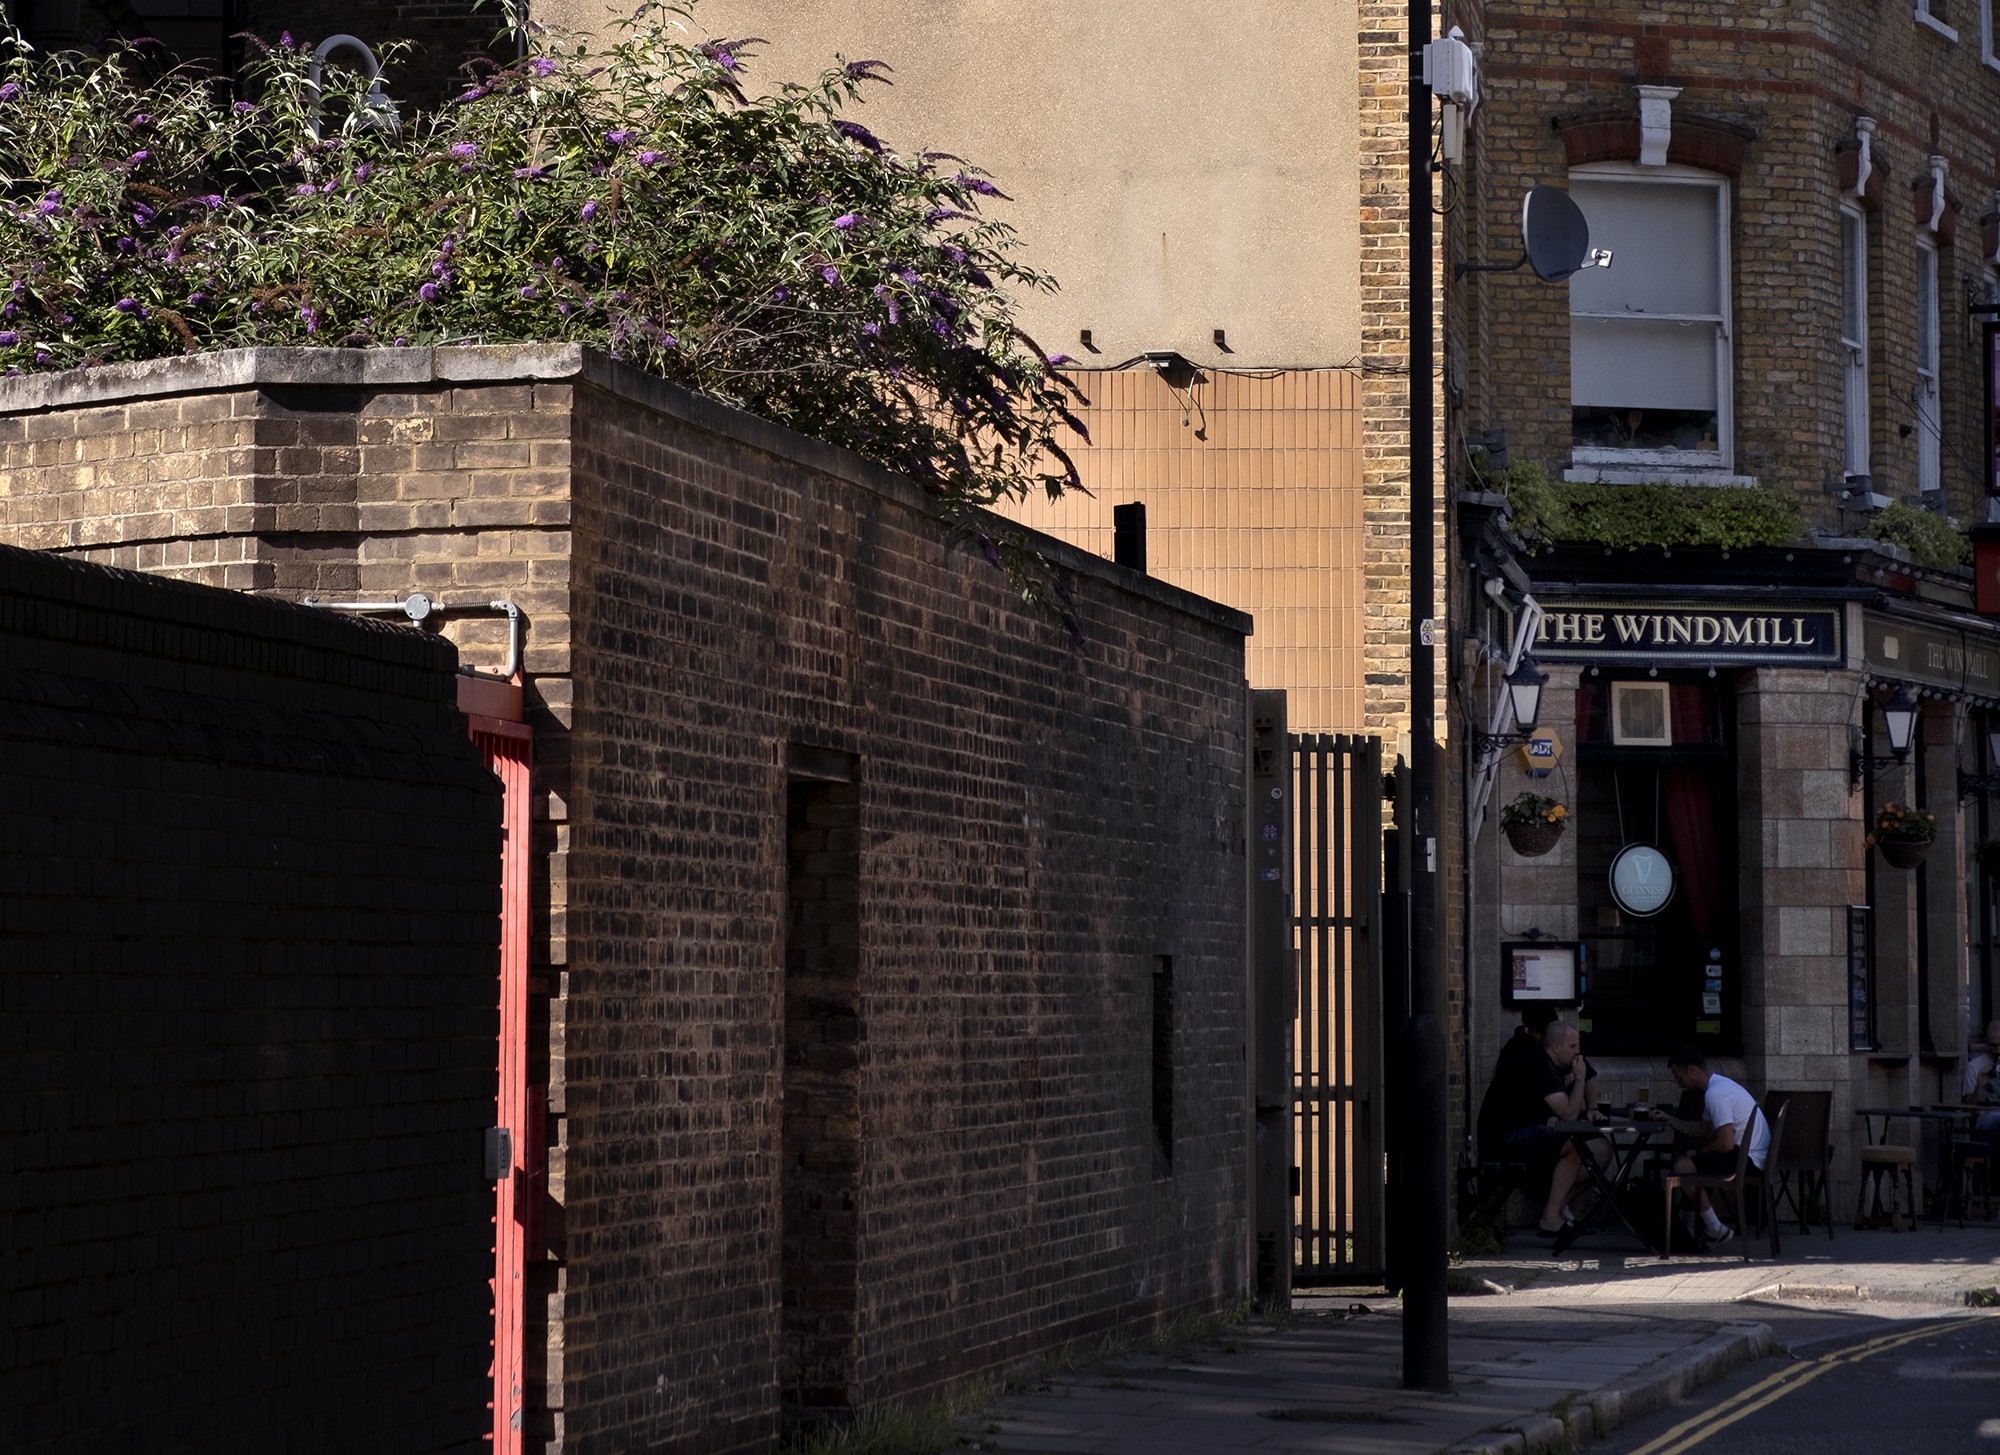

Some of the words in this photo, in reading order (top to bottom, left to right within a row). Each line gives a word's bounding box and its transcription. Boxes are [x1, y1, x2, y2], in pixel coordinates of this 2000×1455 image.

[1535, 612, 1606, 643] THE
[1612, 614, 1815, 647] WINDMILL
[1927, 642, 1945, 670] THE
[1531, 742, 1553, 755] ADT
[1621, 885, 1665, 895] GUINNESS
